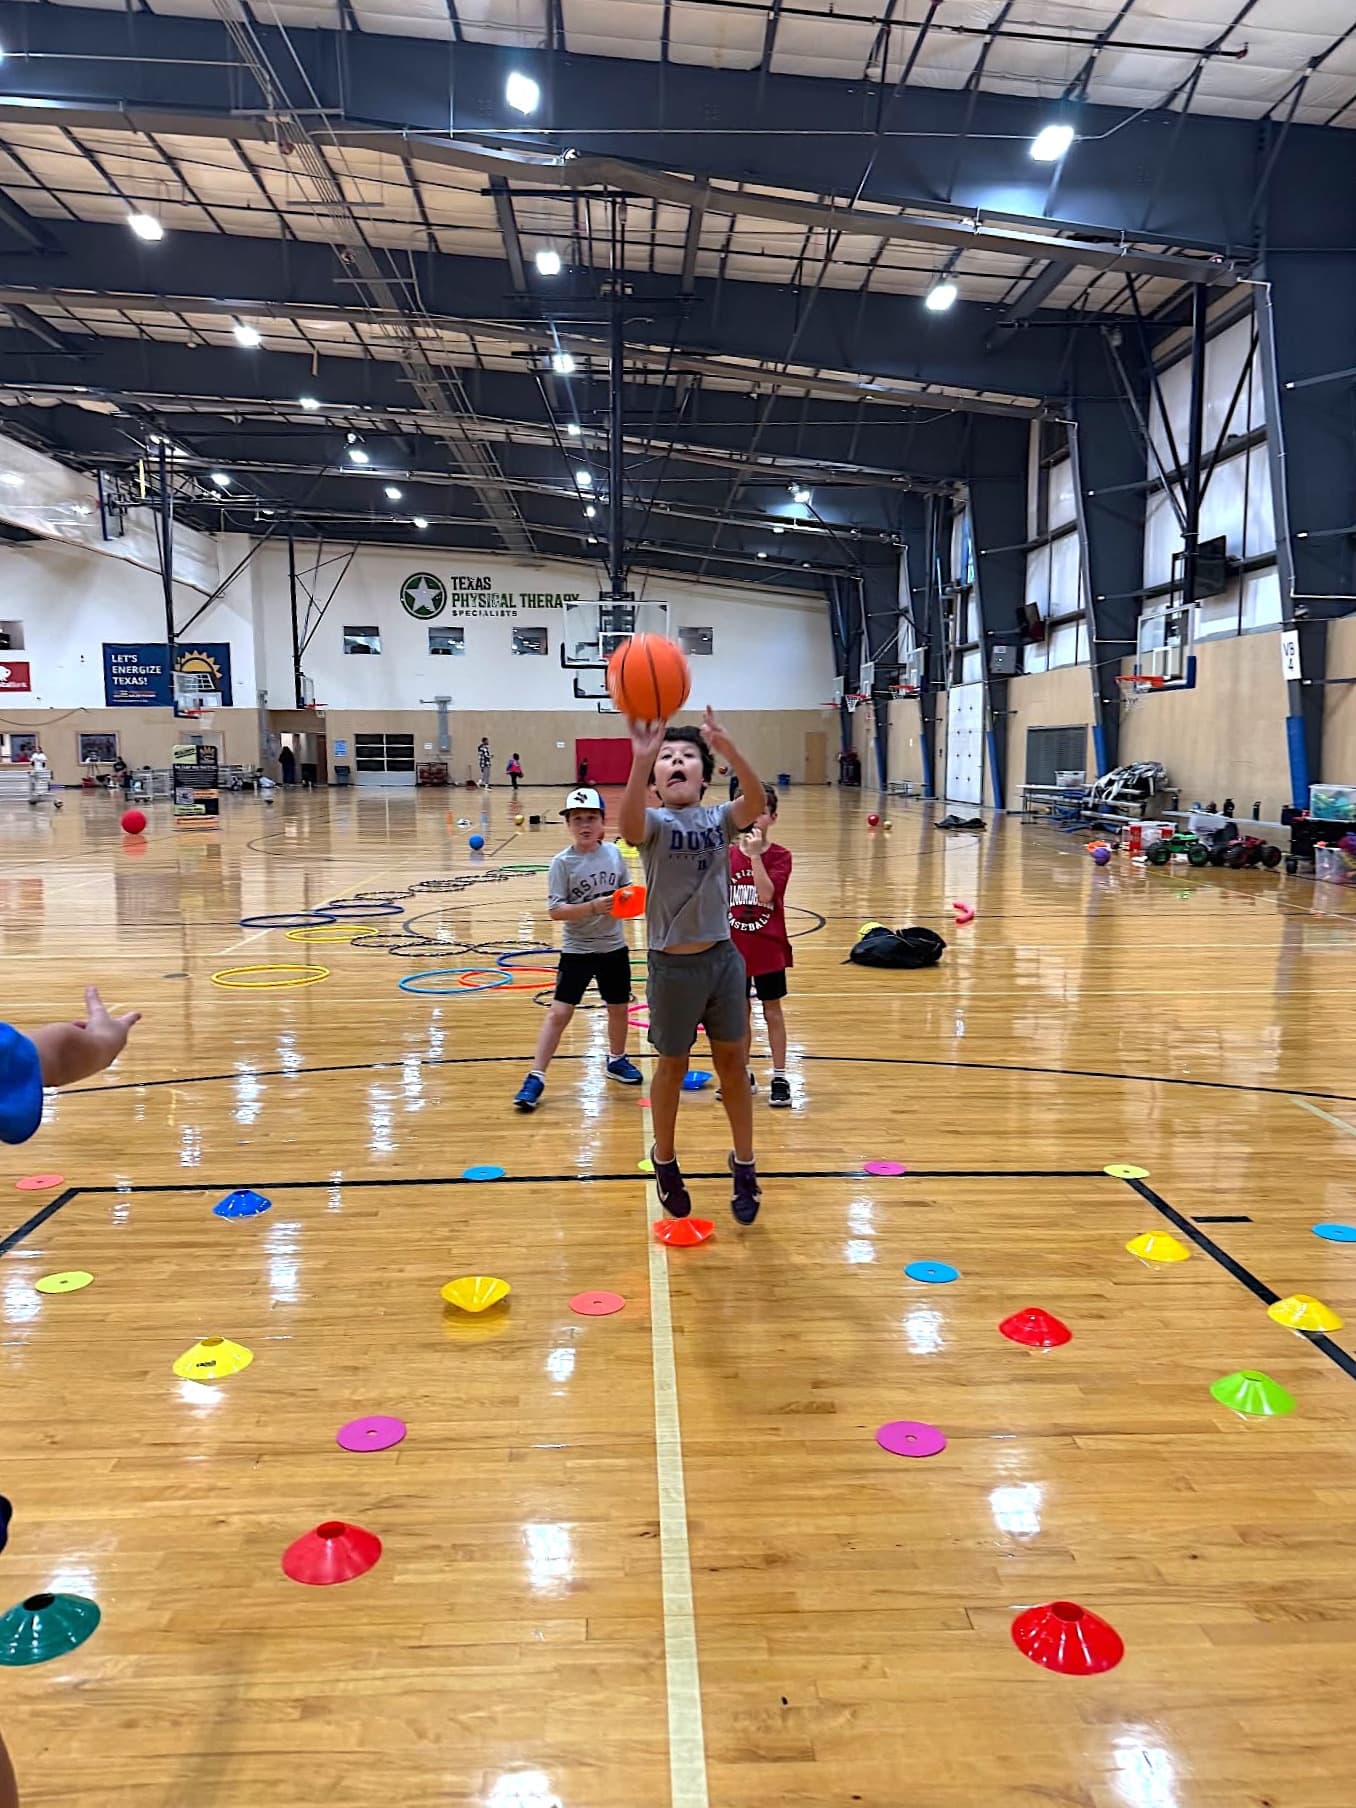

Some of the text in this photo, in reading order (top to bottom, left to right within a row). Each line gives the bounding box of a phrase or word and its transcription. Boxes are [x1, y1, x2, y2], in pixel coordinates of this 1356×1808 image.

[451, 576, 492, 591] TEXAS
[452, 592, 517, 608] PHYSICAL
[452, 609, 518, 617] SPECIALISTS
[1282, 641, 1296, 656] VB
[111, 654, 138, 663] LET'S
[111, 665, 162, 674] ENERGIZE
[111, 676, 148, 686] TEXAS!
